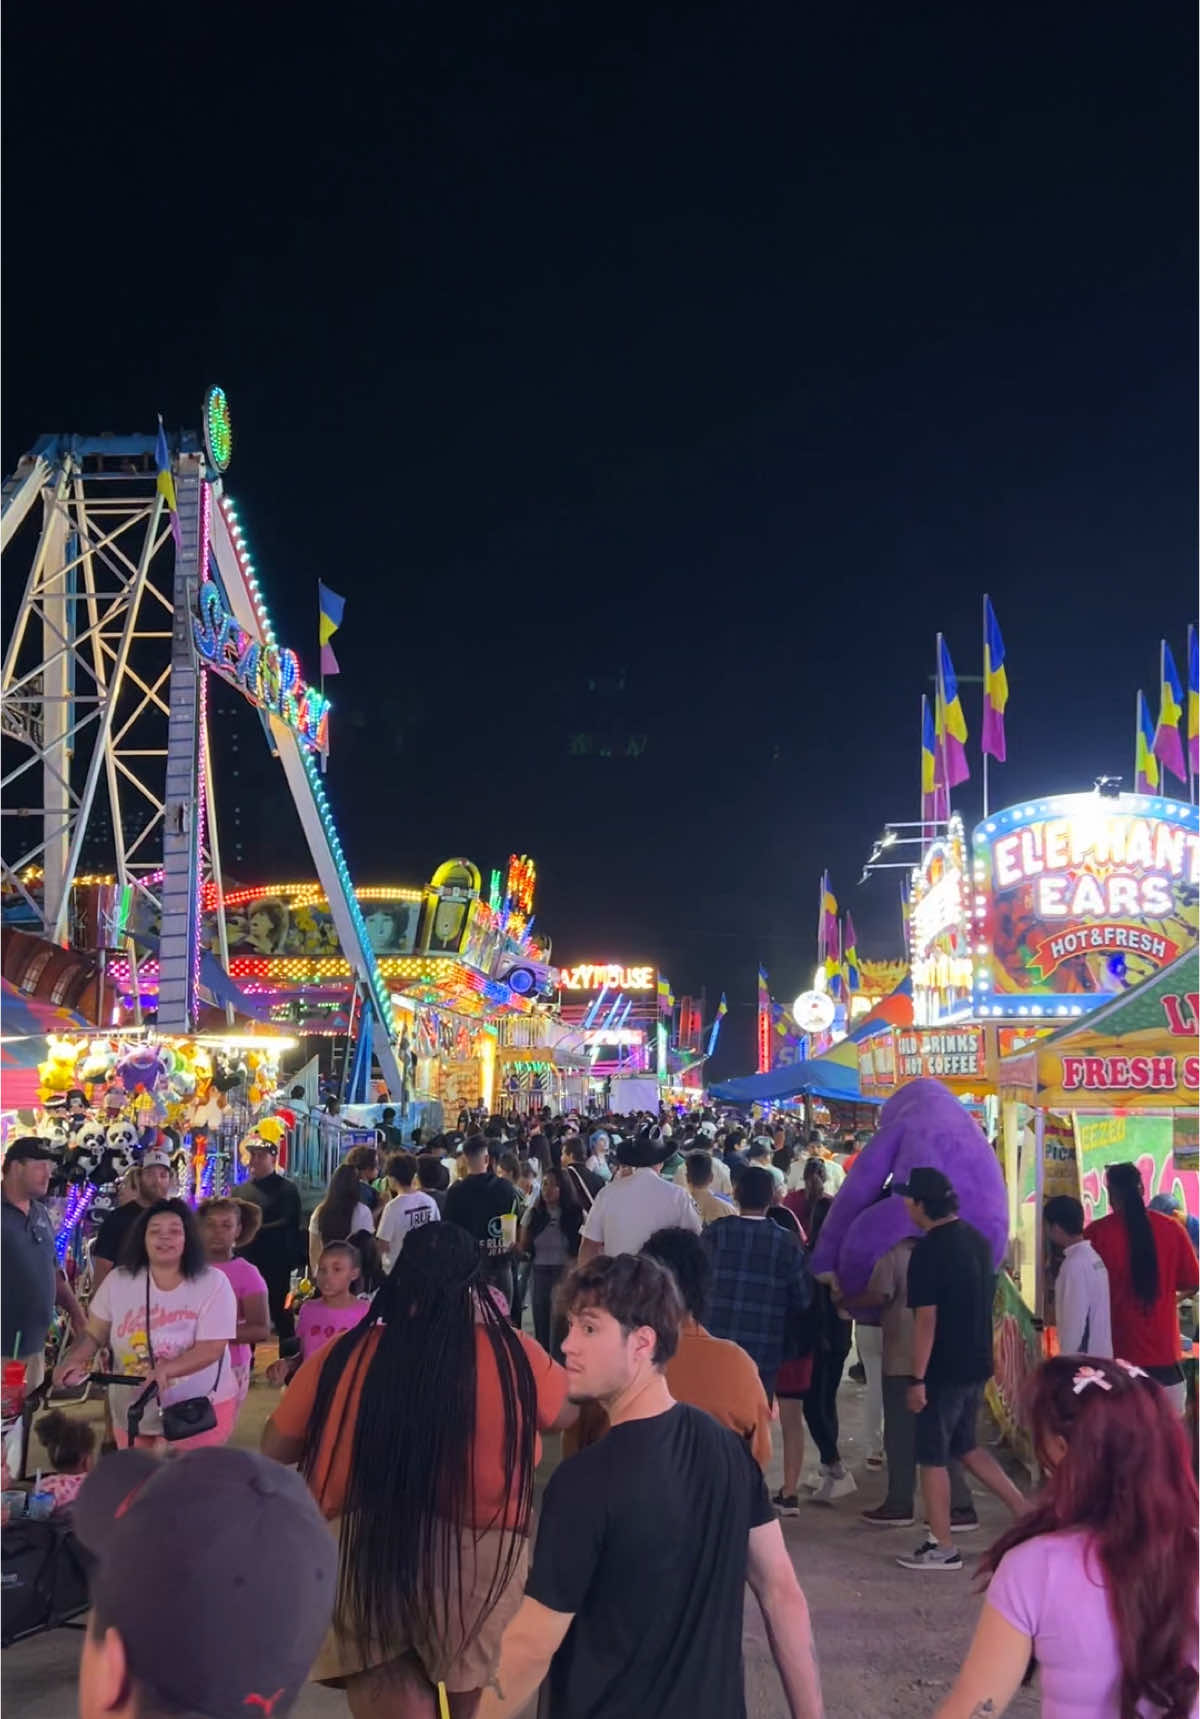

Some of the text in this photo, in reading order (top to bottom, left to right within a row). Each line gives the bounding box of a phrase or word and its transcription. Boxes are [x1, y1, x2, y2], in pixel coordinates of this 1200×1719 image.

[1038, 874, 1174, 915] EARS
[928, 1055, 978, 1074] COFFEE
[1062, 1056, 1176, 1089] FRESH
